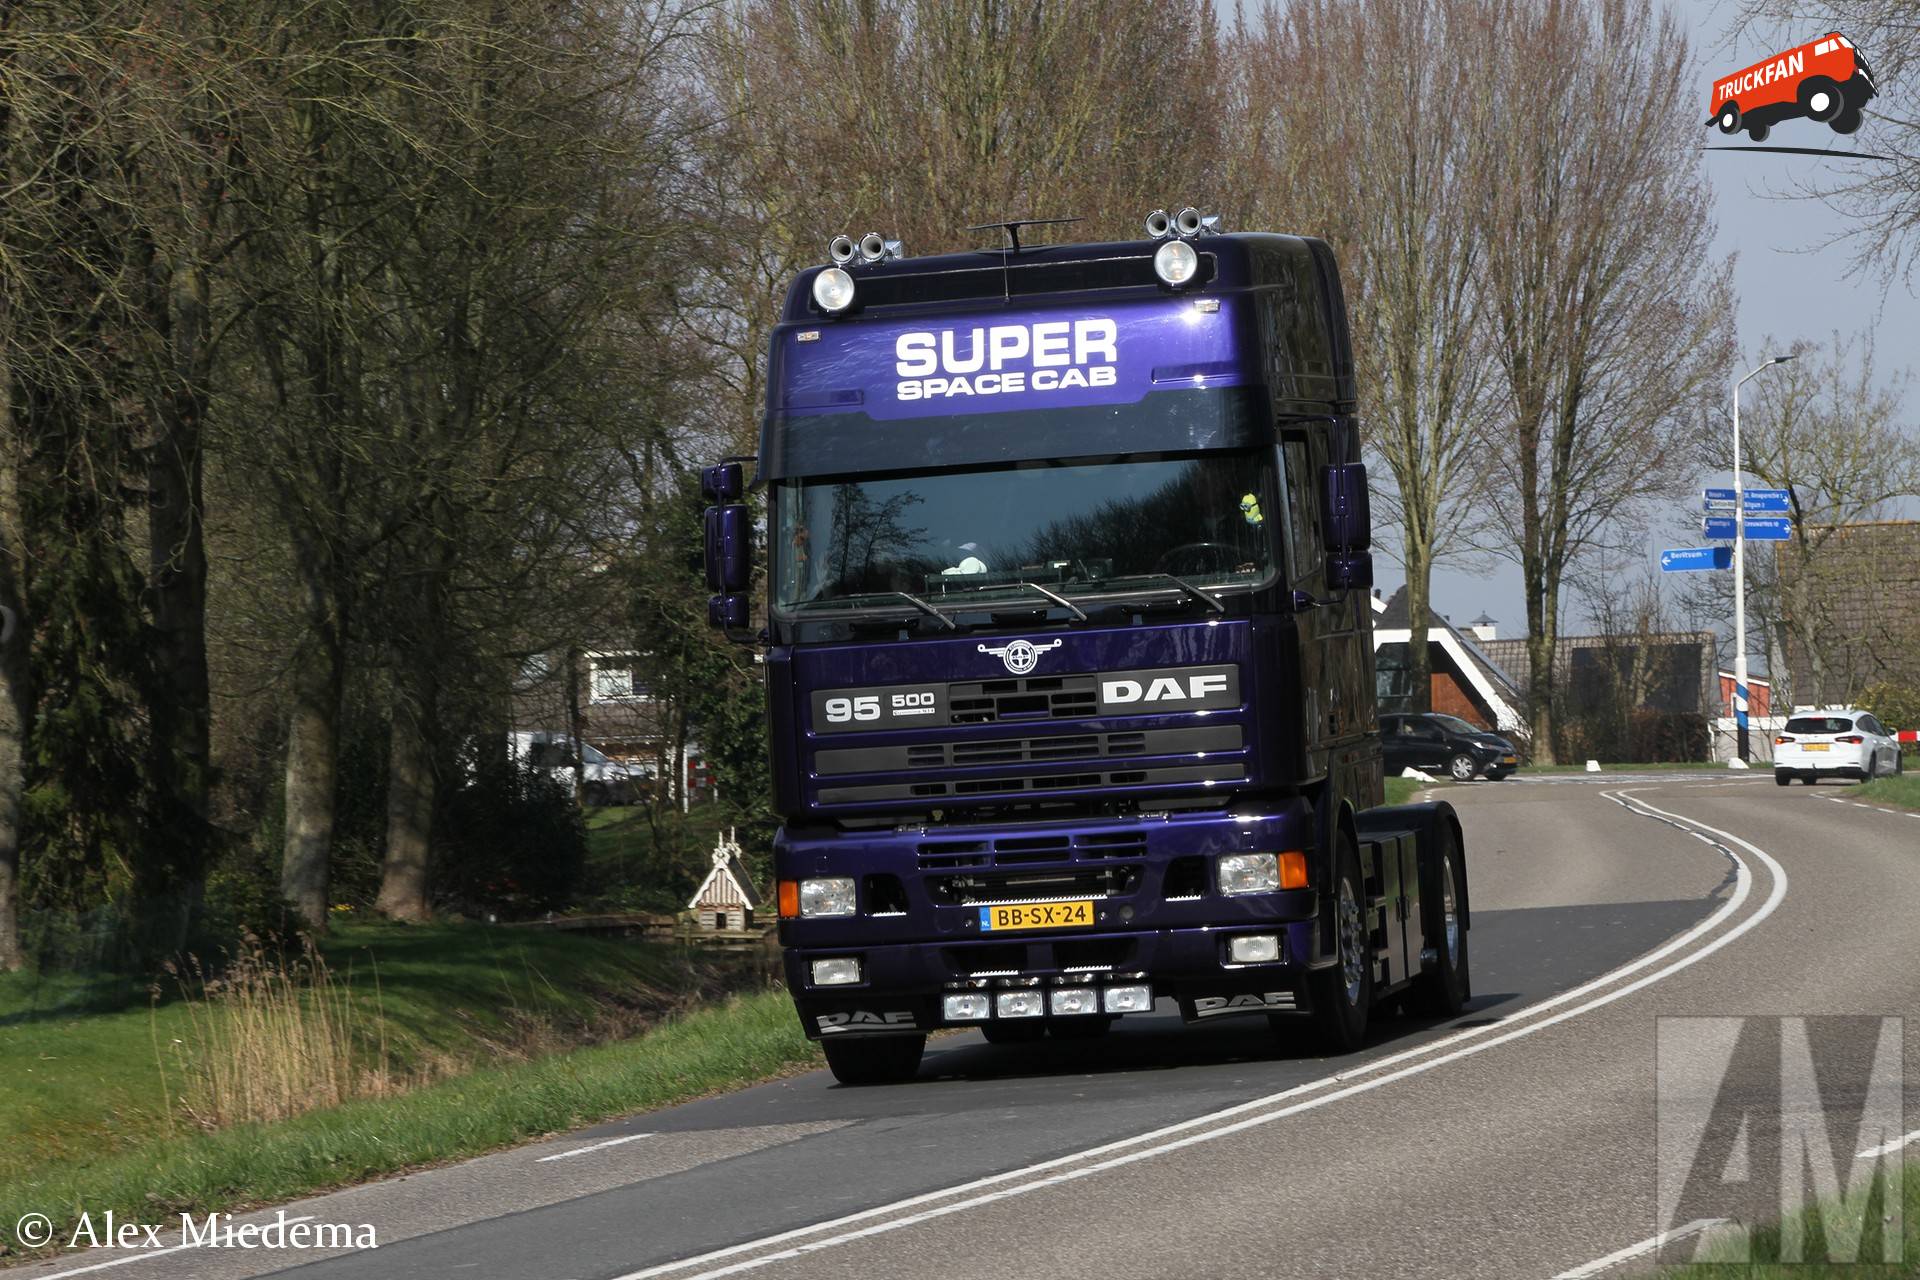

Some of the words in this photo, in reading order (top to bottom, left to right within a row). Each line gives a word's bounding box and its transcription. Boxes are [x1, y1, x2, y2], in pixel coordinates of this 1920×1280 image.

[895, 318, 1118, 377] SUPER
[896, 371, 1026, 400] SPACE
[1031, 366, 1117, 391] CAB
[1102, 674, 1228, 704] DAF
[825, 696, 881, 722] 95
[891, 692, 935, 707] 500
[998, 905, 1087, 926] BB-SX-24
